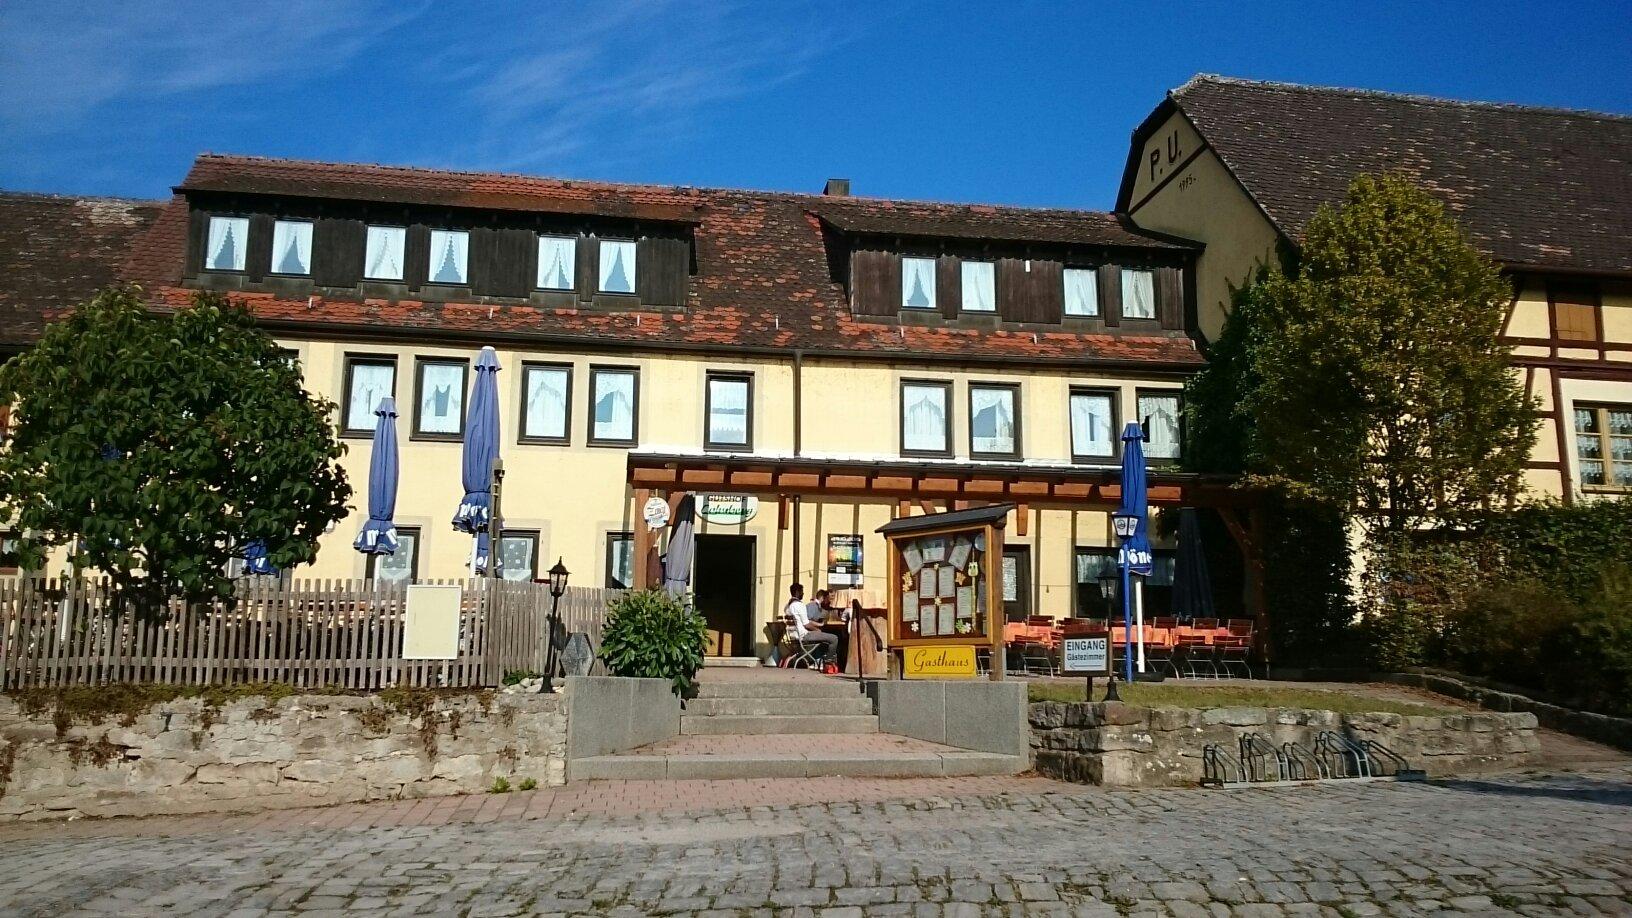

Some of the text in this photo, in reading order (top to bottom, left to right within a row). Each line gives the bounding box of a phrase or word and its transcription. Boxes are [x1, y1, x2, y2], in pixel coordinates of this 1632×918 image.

[707, 494, 747, 502] GUTSHOF
[1066, 640, 1105, 651] EINGANG
[913, 649, 969, 671] Gasthaus
[1066, 653, 1105, 661] Gästezimmer
